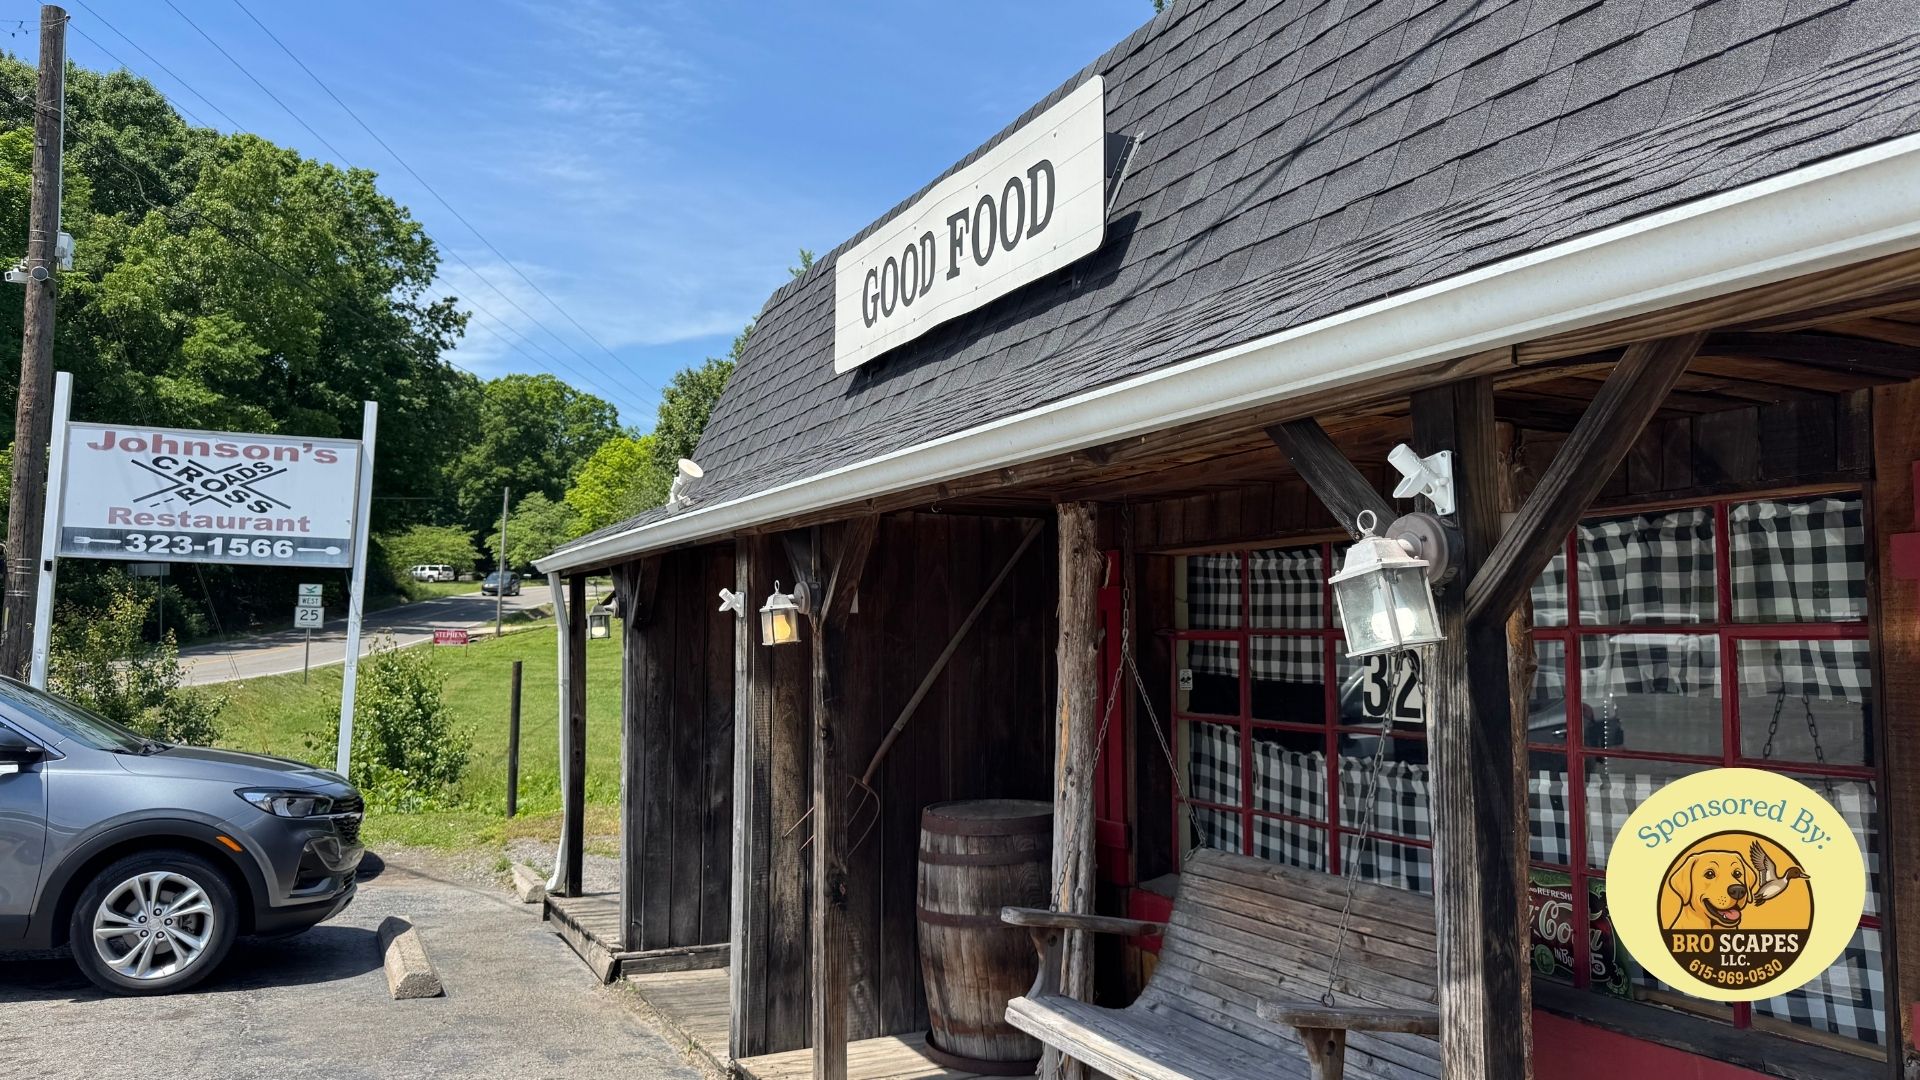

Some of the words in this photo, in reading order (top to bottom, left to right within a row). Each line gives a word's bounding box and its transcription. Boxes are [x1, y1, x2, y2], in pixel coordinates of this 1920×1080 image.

[862, 230, 936, 328] GOOD
[946, 159, 1056, 281] FOOD
[87, 430, 338, 464] Johnson's
[152, 456, 273, 513] CROSS
[108, 506, 310, 532] Restaurant
[125, 533, 293, 558] 323-1566
[300, 609, 318, 620] 25
